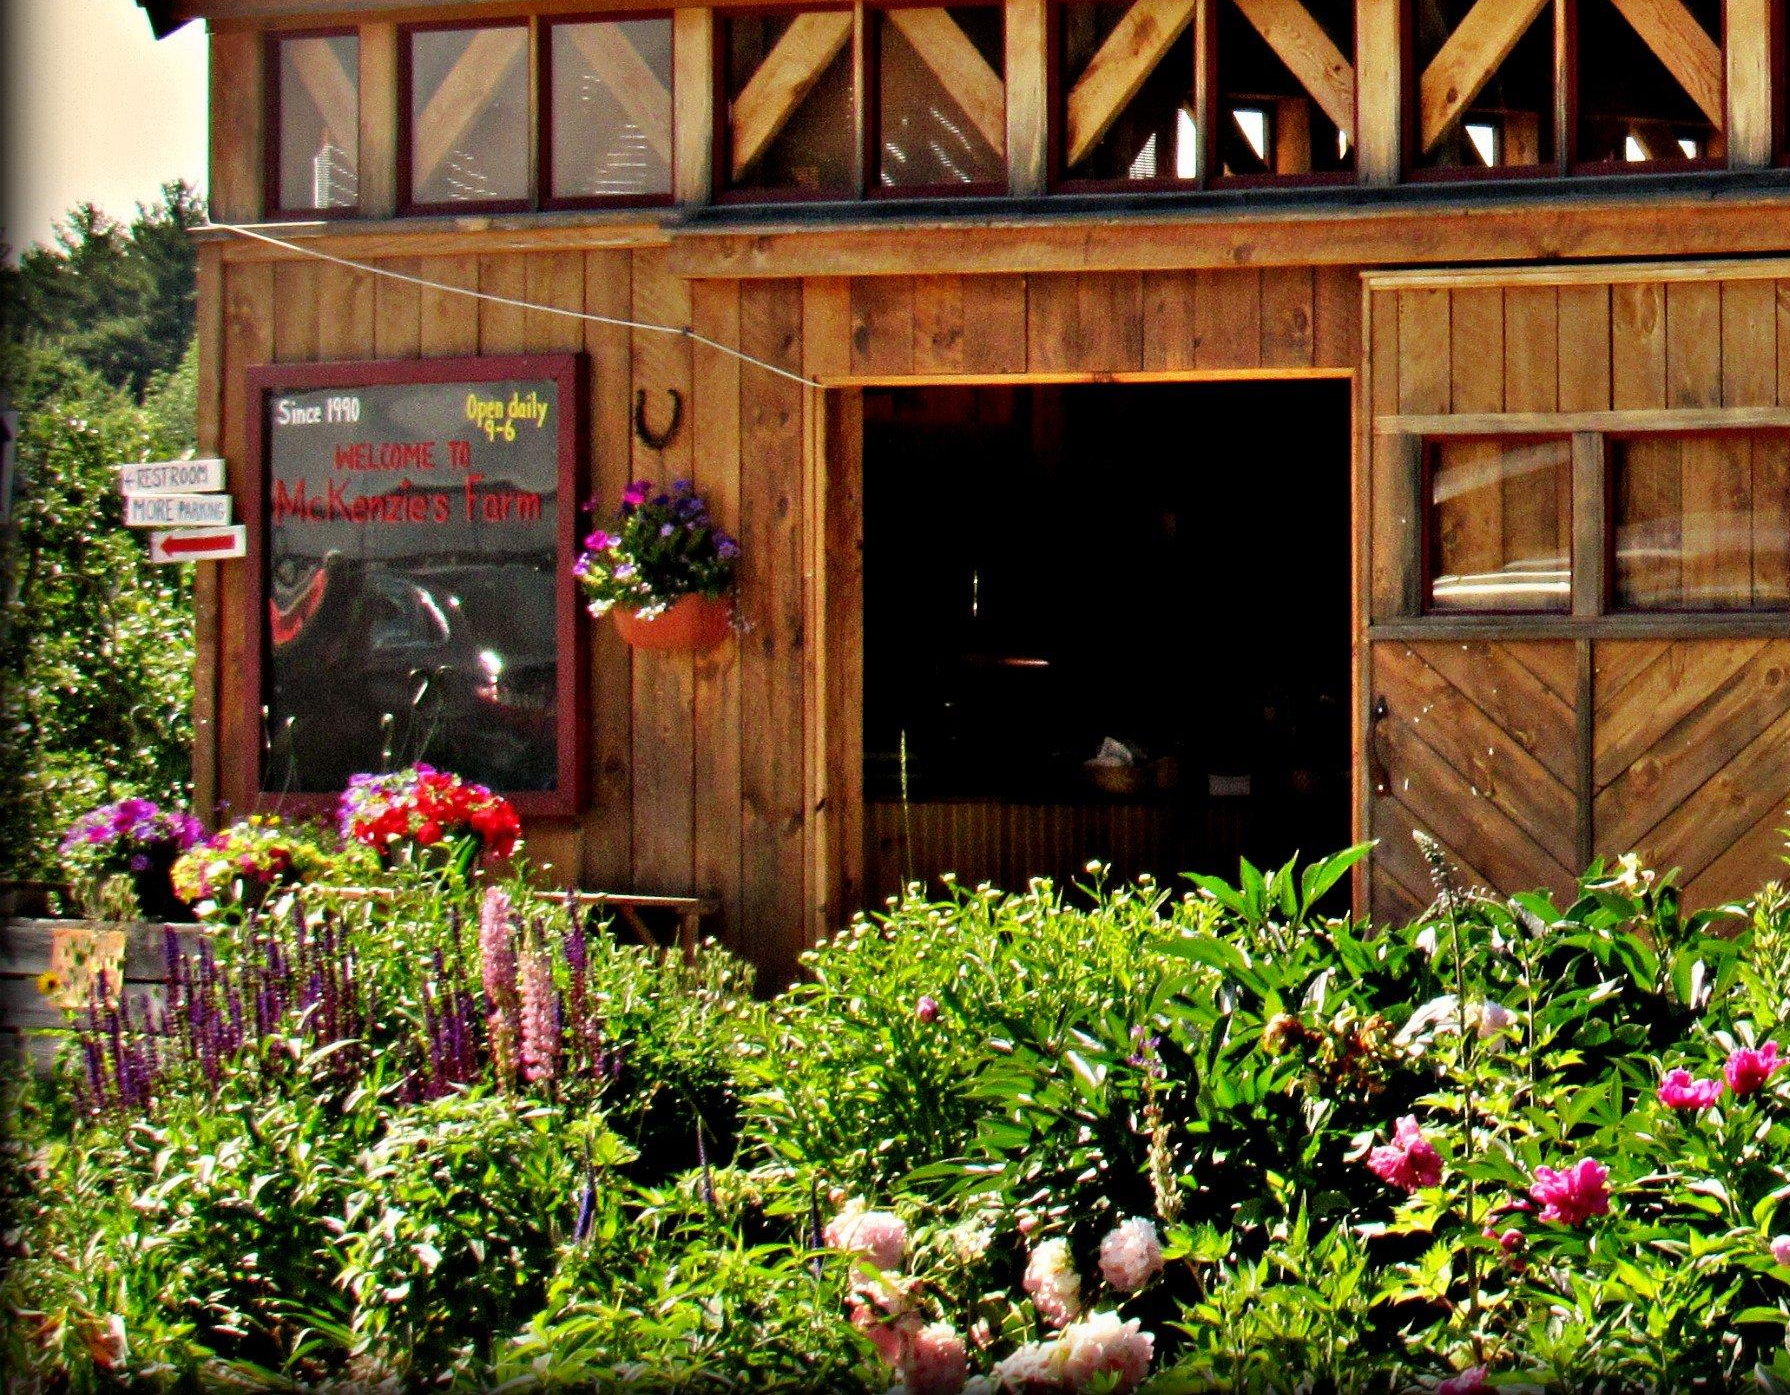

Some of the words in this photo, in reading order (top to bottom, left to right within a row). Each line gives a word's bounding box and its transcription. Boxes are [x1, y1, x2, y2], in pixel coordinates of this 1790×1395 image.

[278, 397, 322, 424] Since
[326, 396, 361, 423] 1990
[465, 393, 504, 427] Open
[508, 391, 548, 428] daily
[484, 418, 516, 442] 9-6
[334, 441, 436, 471] WELCOME
[446, 440, 471, 468] TO
[133, 499, 175, 521] MORE
[465, 473, 542, 522] Farm
